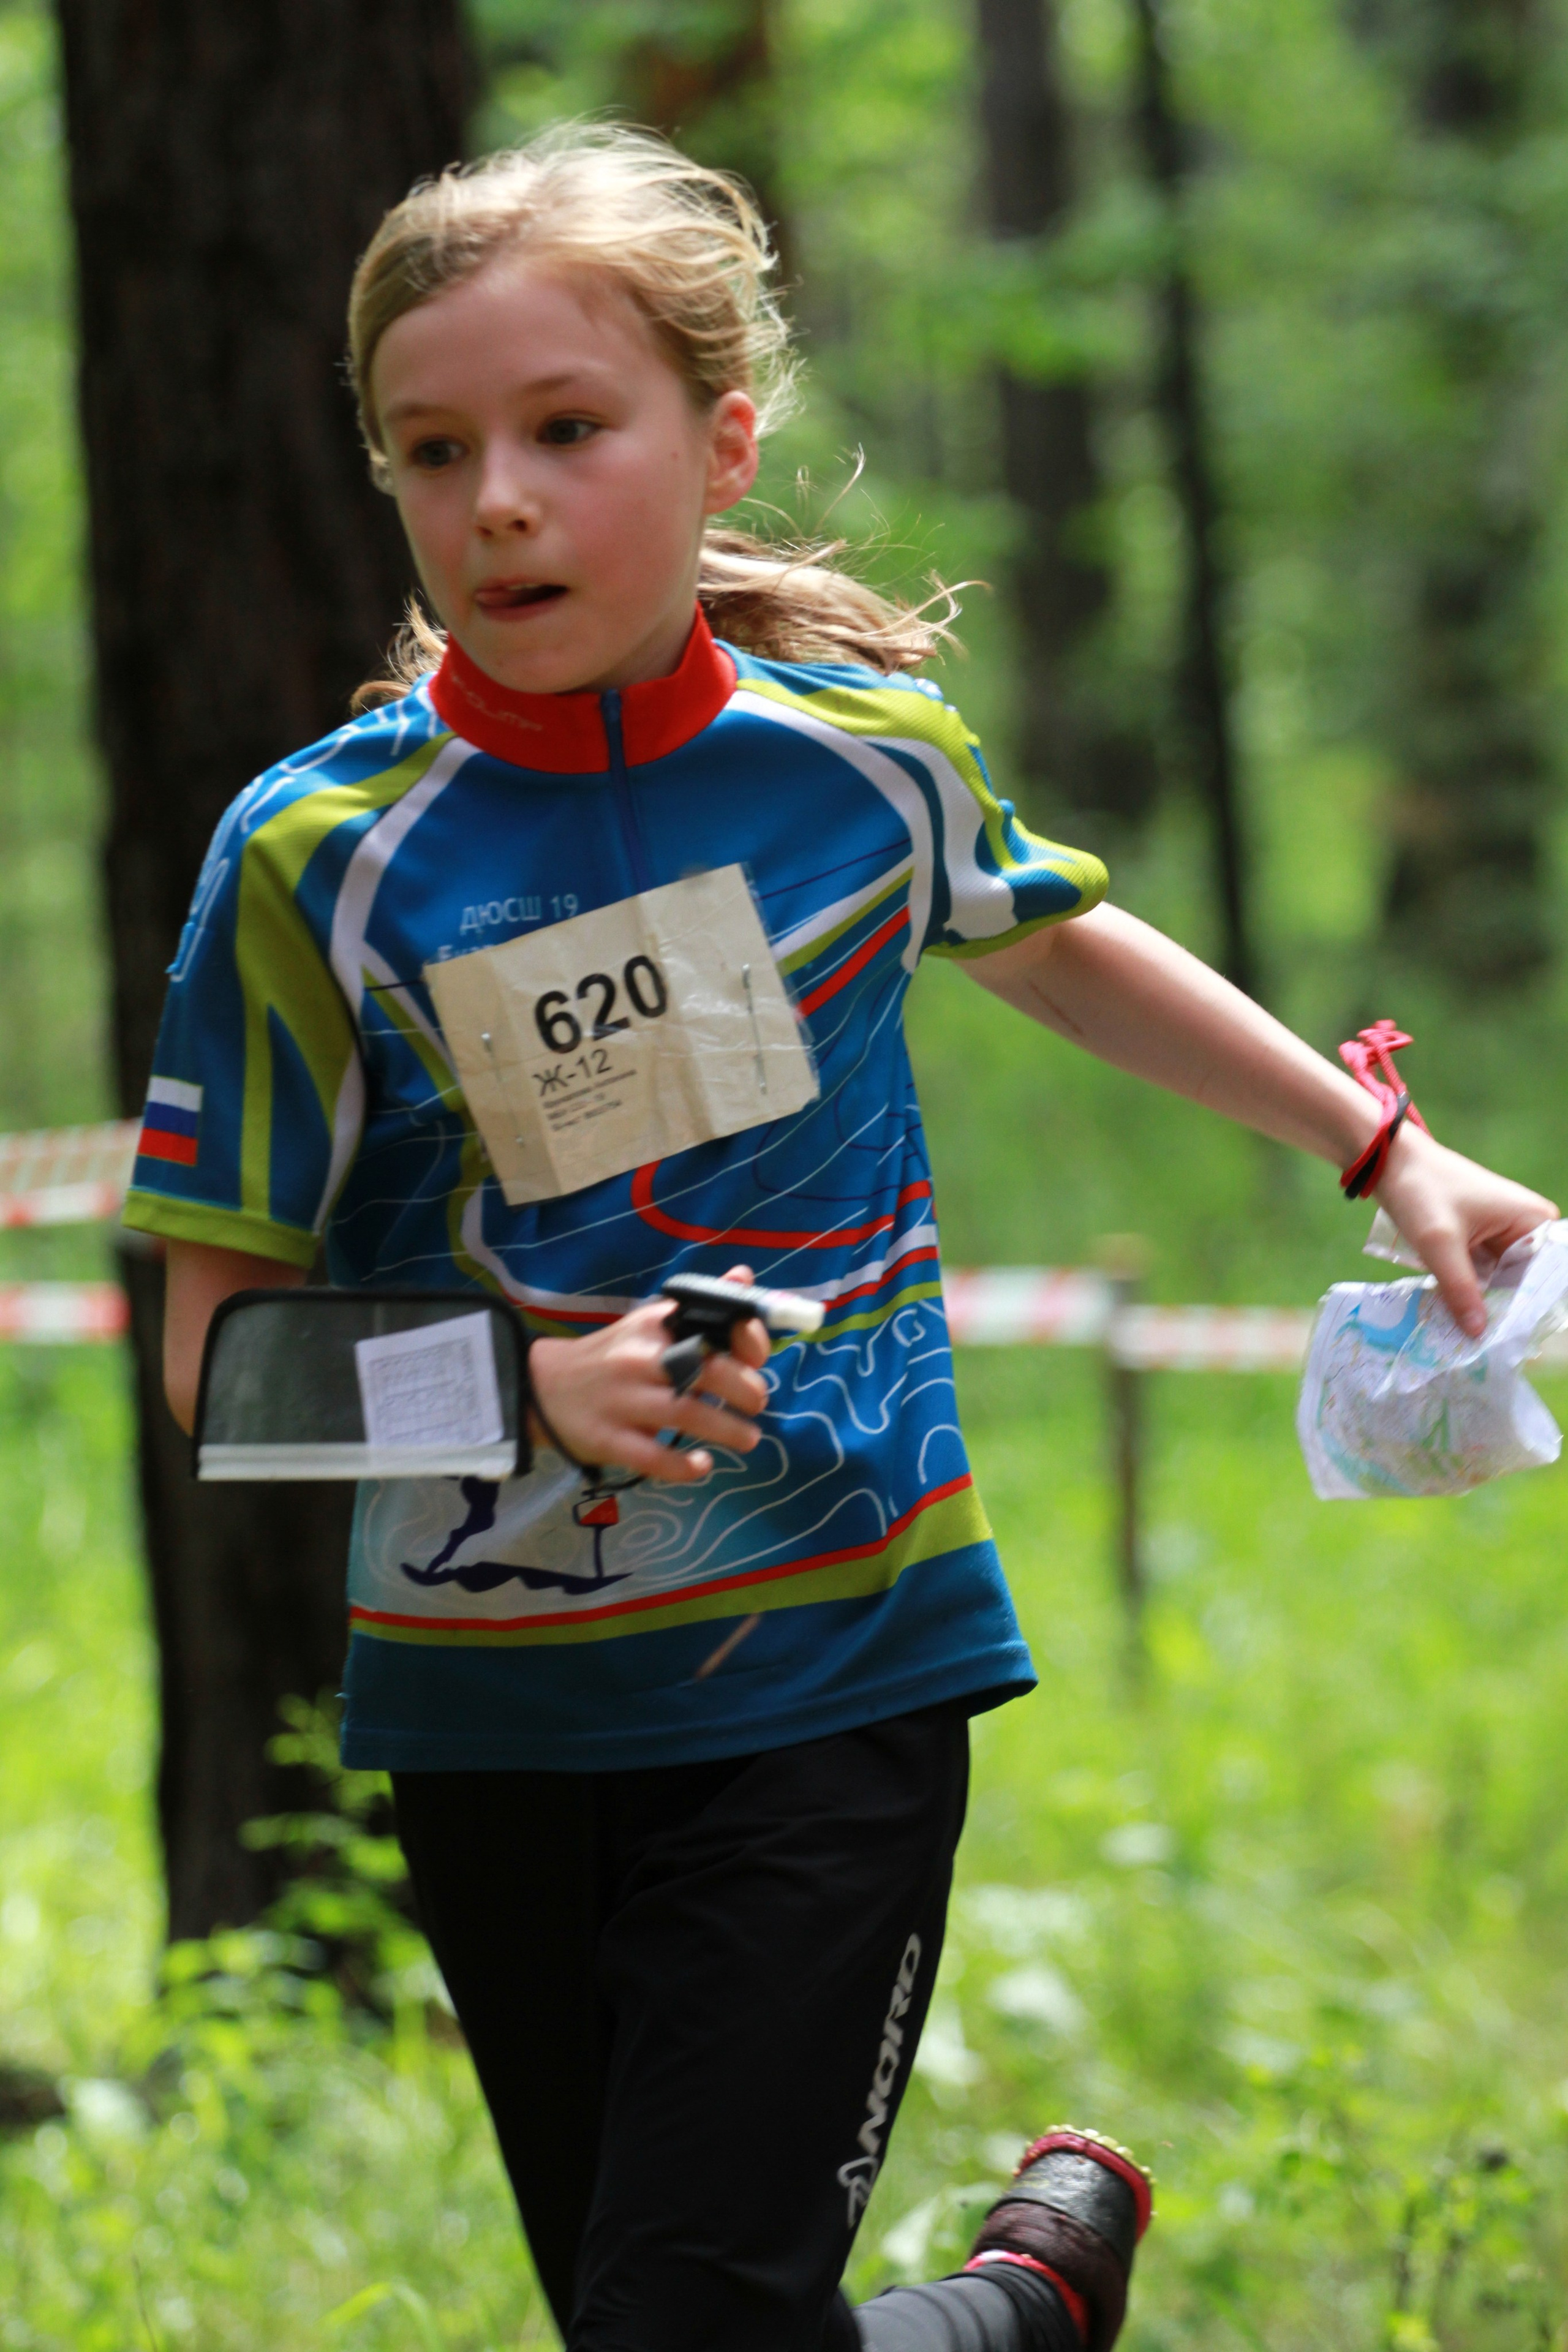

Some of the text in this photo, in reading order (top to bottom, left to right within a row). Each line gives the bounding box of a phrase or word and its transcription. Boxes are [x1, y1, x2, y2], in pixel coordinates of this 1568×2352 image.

[459, 893, 579, 936] ДЮСШ 19
[533, 955, 669, 1055] 620
[532, 1047, 614, 1097] Ж-12
[857, 1932, 922, 2156] NORD
